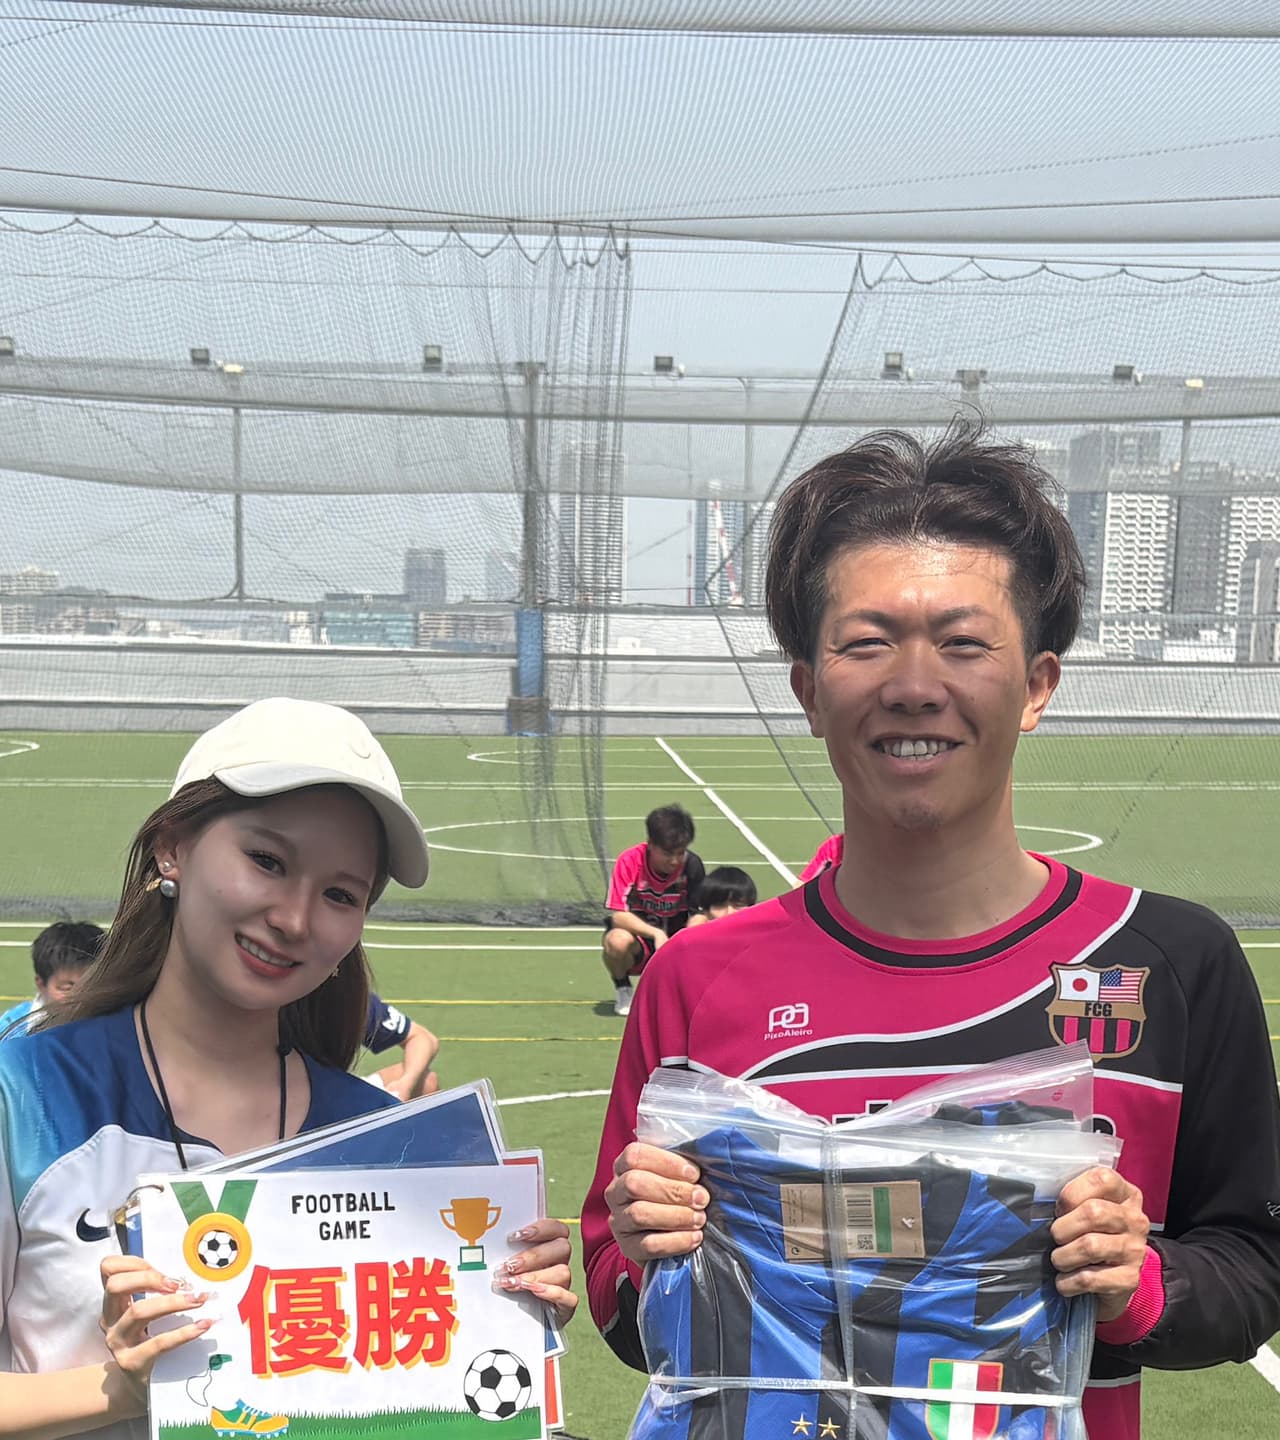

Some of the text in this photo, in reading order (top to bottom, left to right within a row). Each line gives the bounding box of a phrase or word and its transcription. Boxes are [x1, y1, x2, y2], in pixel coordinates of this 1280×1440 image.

[1084, 1002, 1113, 1017] FCG
[291, 1191, 396, 1214] FOOTBALL
[319, 1219, 371, 1241] GAME
[237, 1256, 460, 1380] 優勝
